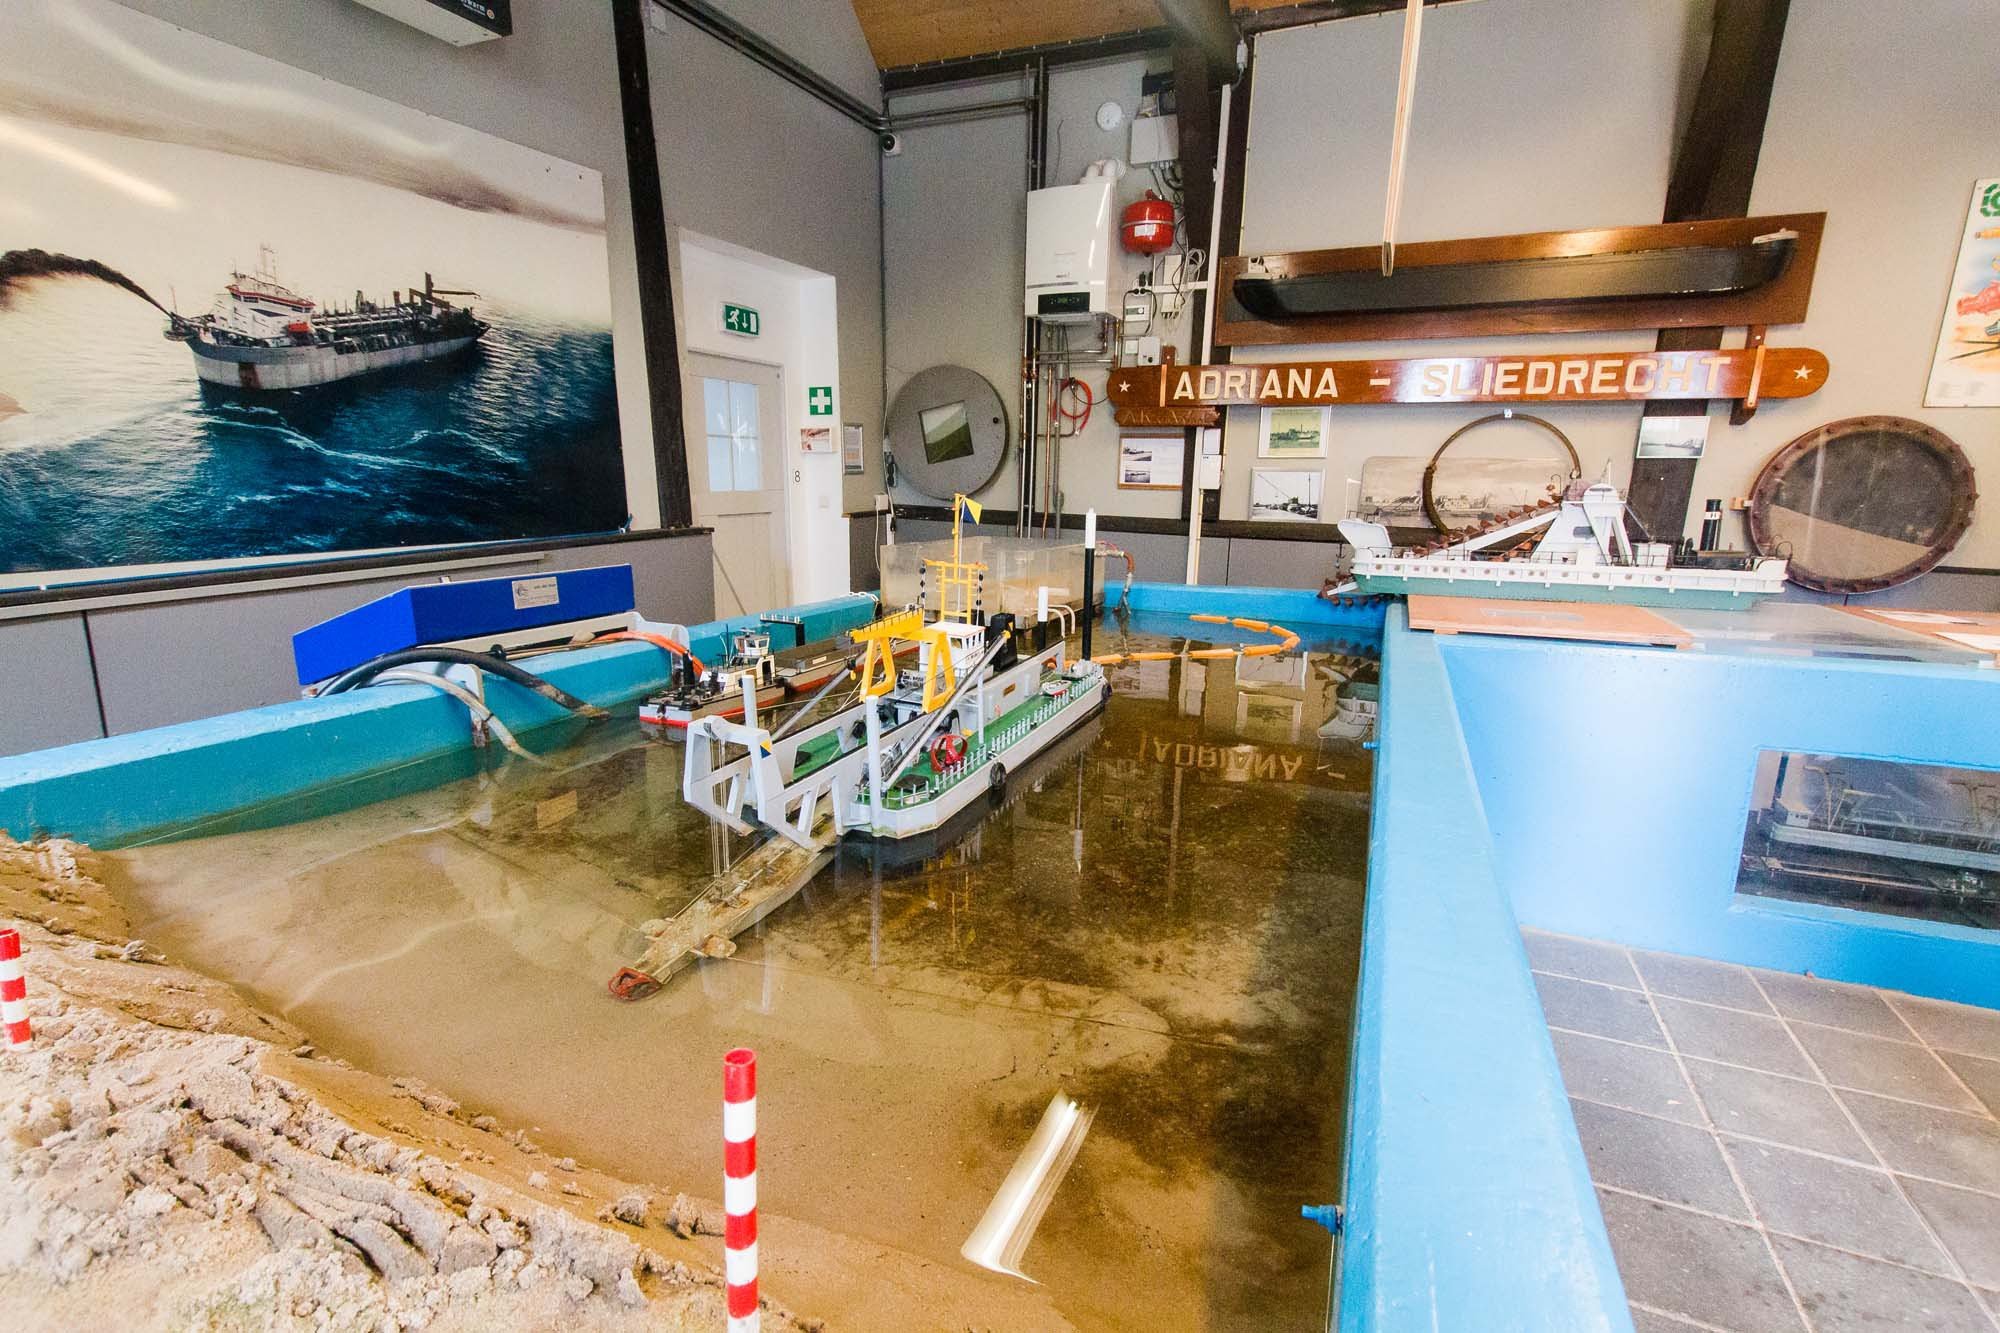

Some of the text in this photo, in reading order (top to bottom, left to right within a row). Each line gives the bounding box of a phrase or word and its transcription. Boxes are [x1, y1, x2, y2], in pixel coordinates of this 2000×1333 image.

[1173, 367, 1338, 400] ADRIANA
[1423, 357, 1731, 396] SLIEDRECHT
[794, 470, 801, 483] 8
